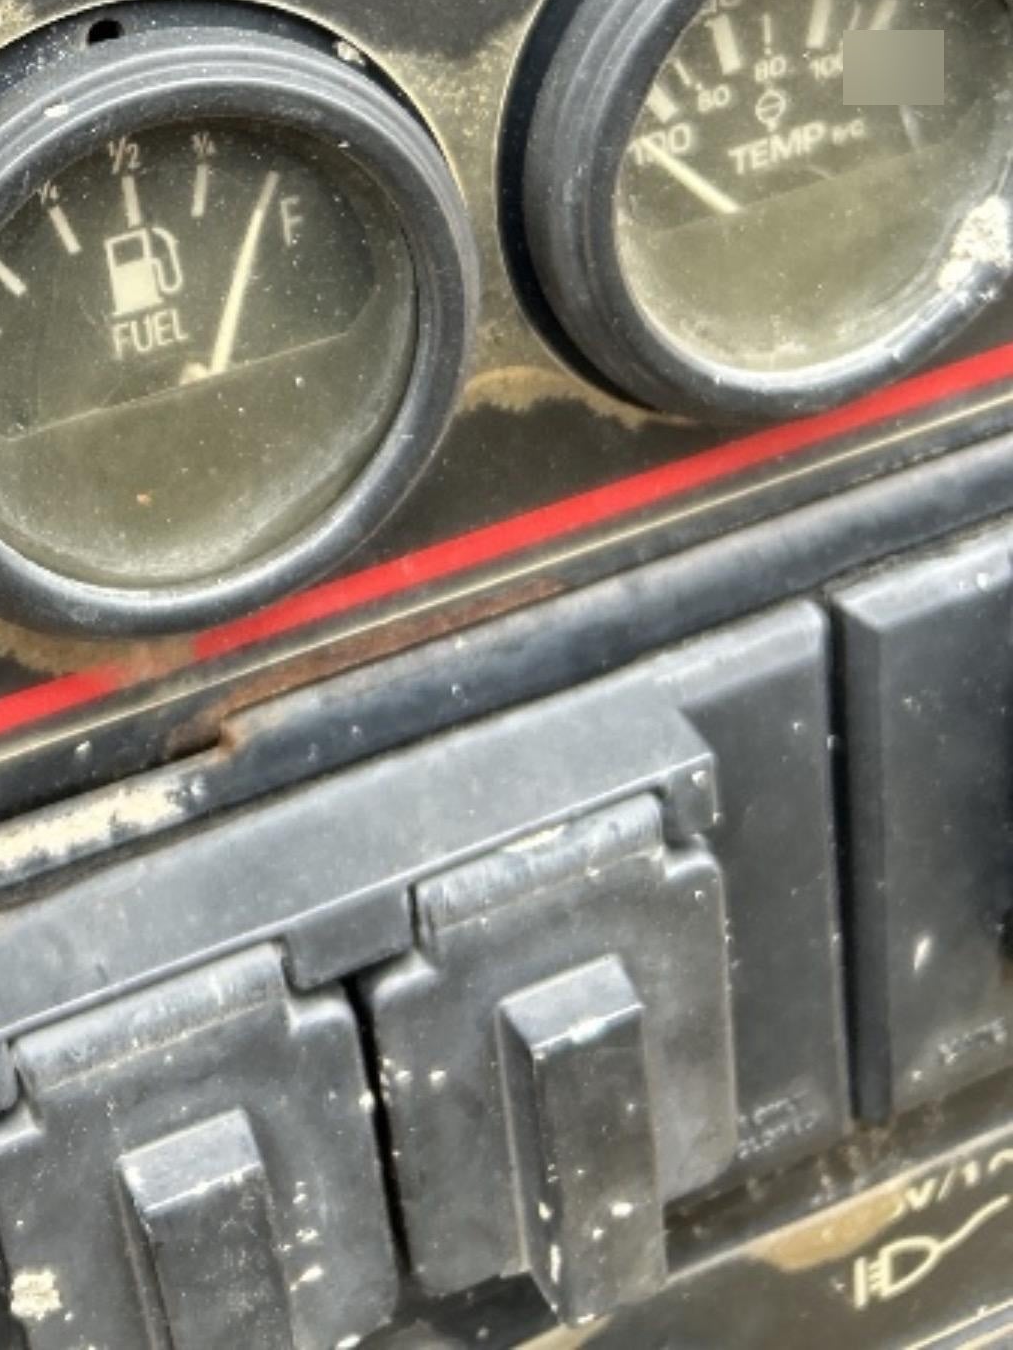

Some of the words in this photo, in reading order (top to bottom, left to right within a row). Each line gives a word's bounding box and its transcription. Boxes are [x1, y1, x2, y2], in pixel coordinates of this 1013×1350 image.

[728, 120, 826, 175] TEMP
[279, 193, 305, 249] F
[110, 308, 189, 361] FUEL
